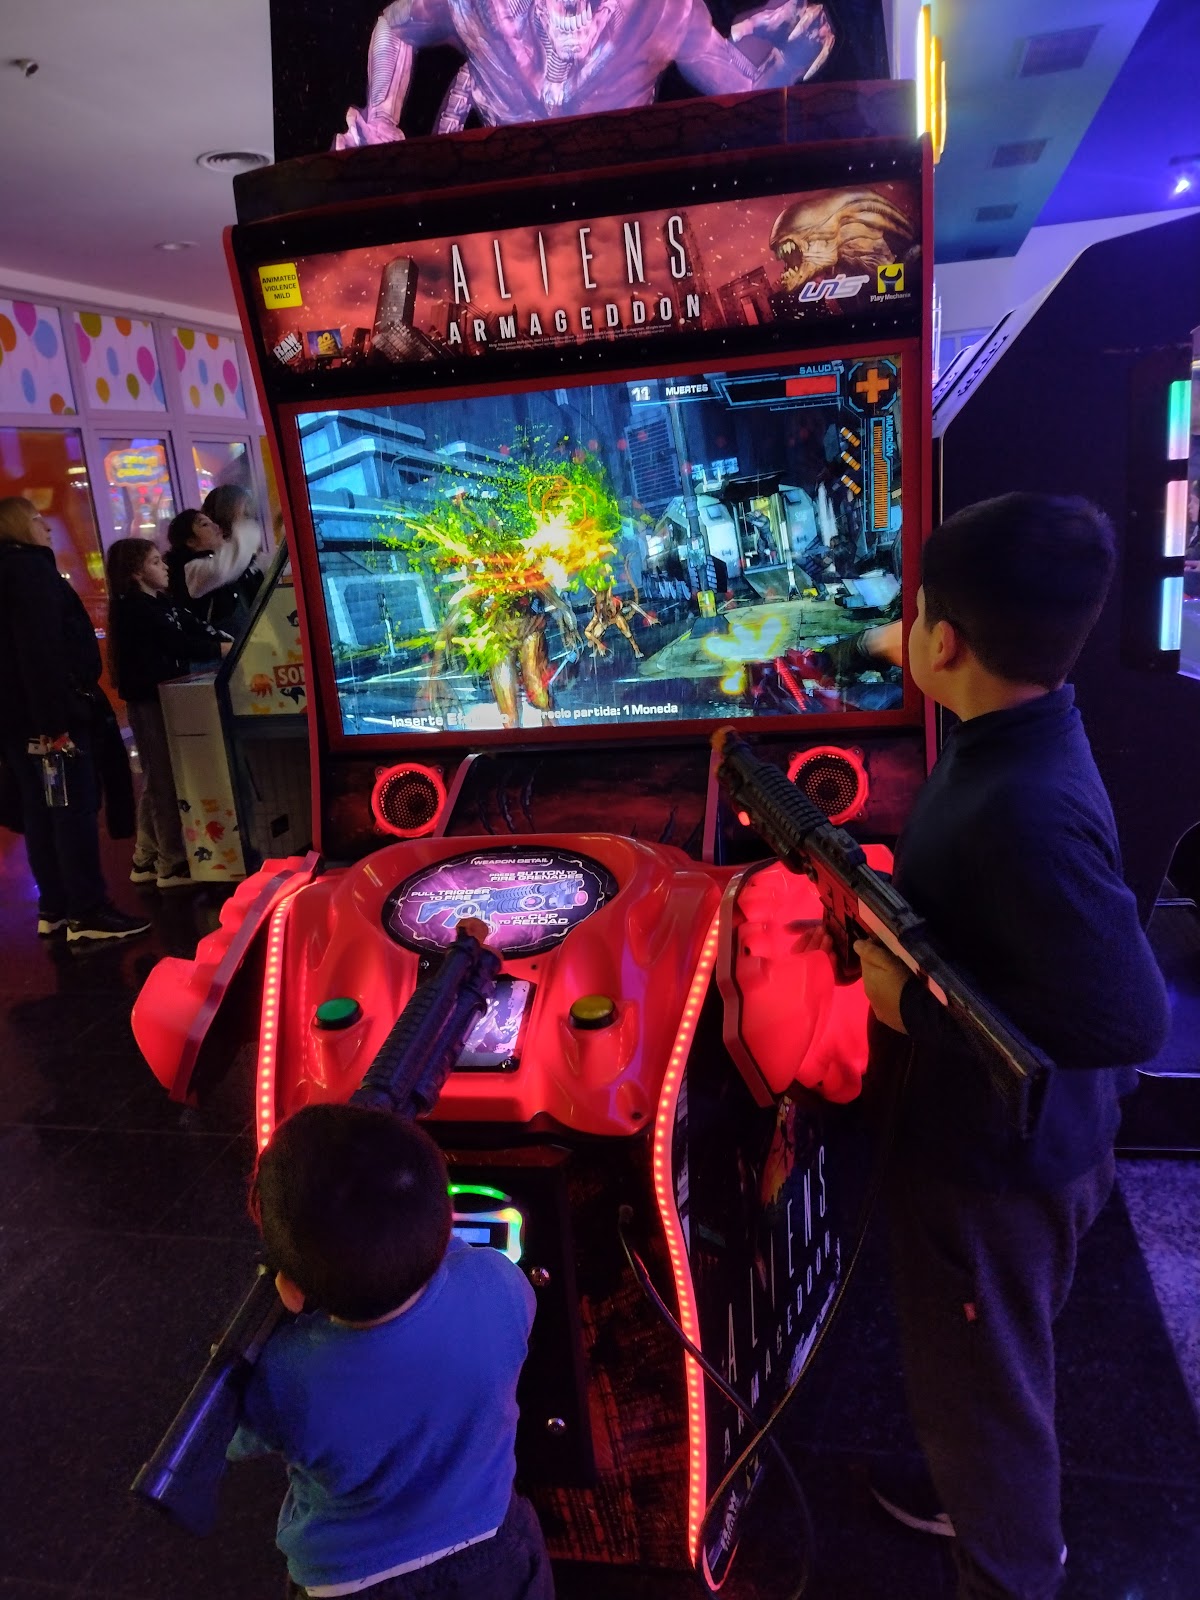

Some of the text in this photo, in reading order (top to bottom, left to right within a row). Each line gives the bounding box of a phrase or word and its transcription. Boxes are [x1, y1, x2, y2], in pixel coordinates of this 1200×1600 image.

[452, 215, 687, 304] ALIENS
[262, 274, 296, 284] ANIMATED
[264, 283, 297, 292] VIOLENCE
[273, 292, 291, 300] MILD
[870, 294, 885, 302] Play
[448, 294, 700, 345] ARMAGEDDON
[273, 333, 298, 358] RAW
[799, 363, 831, 375] SALUD
[665, 383, 709, 396] MUERTES
[573, 705, 621, 720] partida:
[623, 704, 630, 715] 1
[631, 702, 679, 715] Moneda
[473, 858, 516, 866] WEAPON
[516, 869, 565, 877] BUTTON
[518, 873, 584, 881] GRENADES
[512, 918, 569, 926] RELOAD
[728, 1144, 826, 1384] ALIENS
